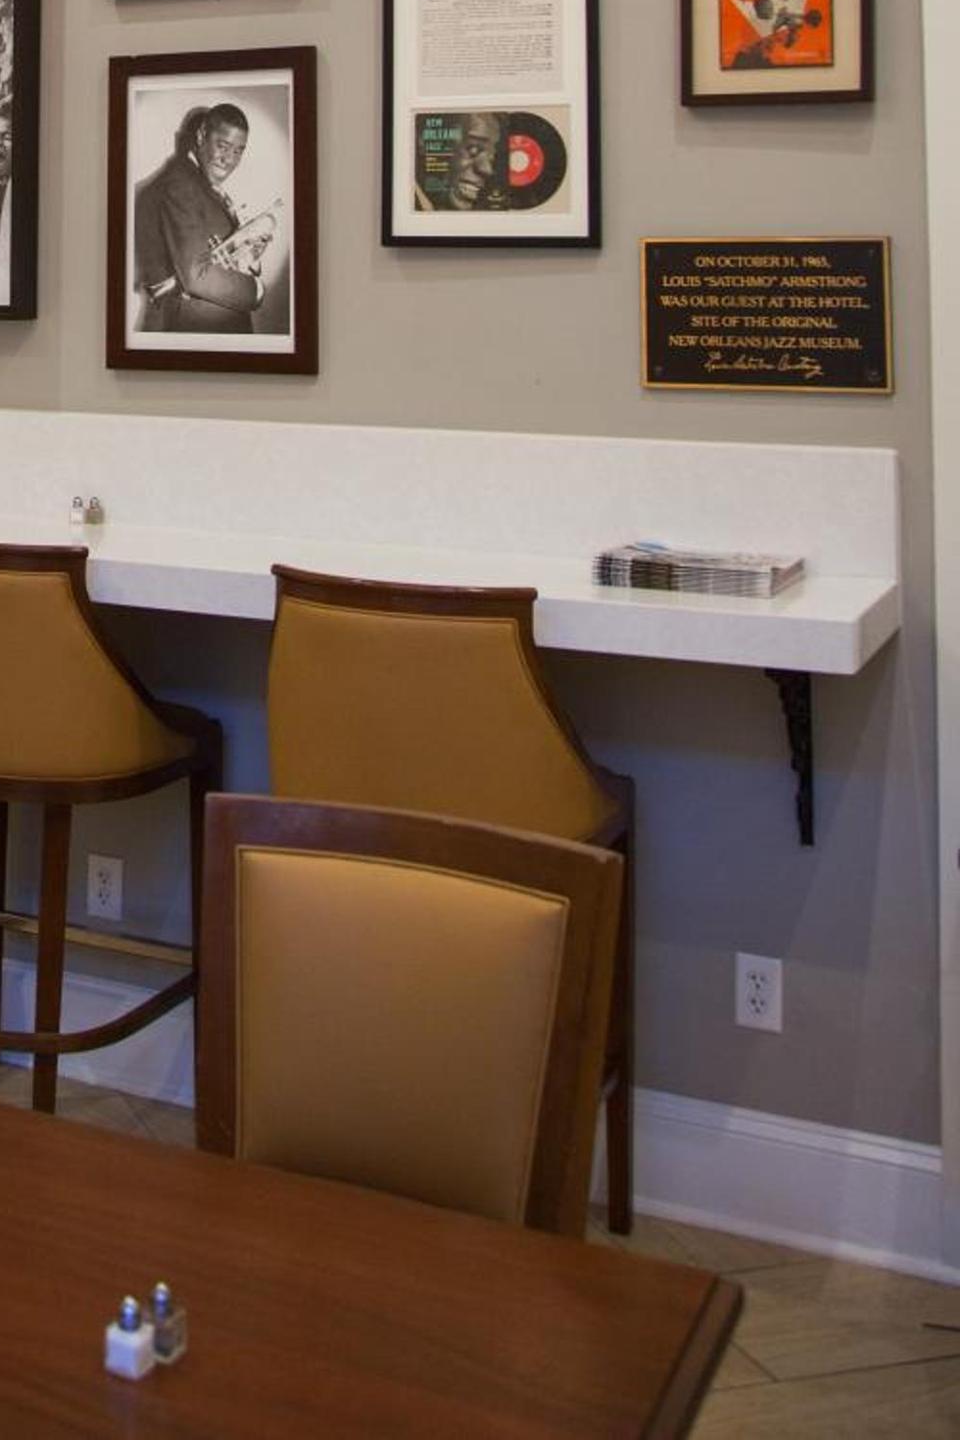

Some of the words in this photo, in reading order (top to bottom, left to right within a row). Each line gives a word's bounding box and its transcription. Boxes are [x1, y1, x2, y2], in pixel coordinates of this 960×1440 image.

[695, 256, 715, 268] ON
[717, 256, 779, 268] OCTOBER
[662, 275, 702, 287] LOUIS
[660, 295, 689, 308] WAS
[690, 295, 720, 307] OUR
[721, 296, 764, 308] GUEST
[767, 296, 787, 308] AT
[788, 296, 816, 308] THE
[691, 316, 720, 328] SITE
[721, 316, 741, 327] OF
[742, 316, 770, 328] THE
[668, 335, 699, 347] NEW
[700, 335, 762, 348] ORLEANS
[763, 336, 797, 349] JAZZ
